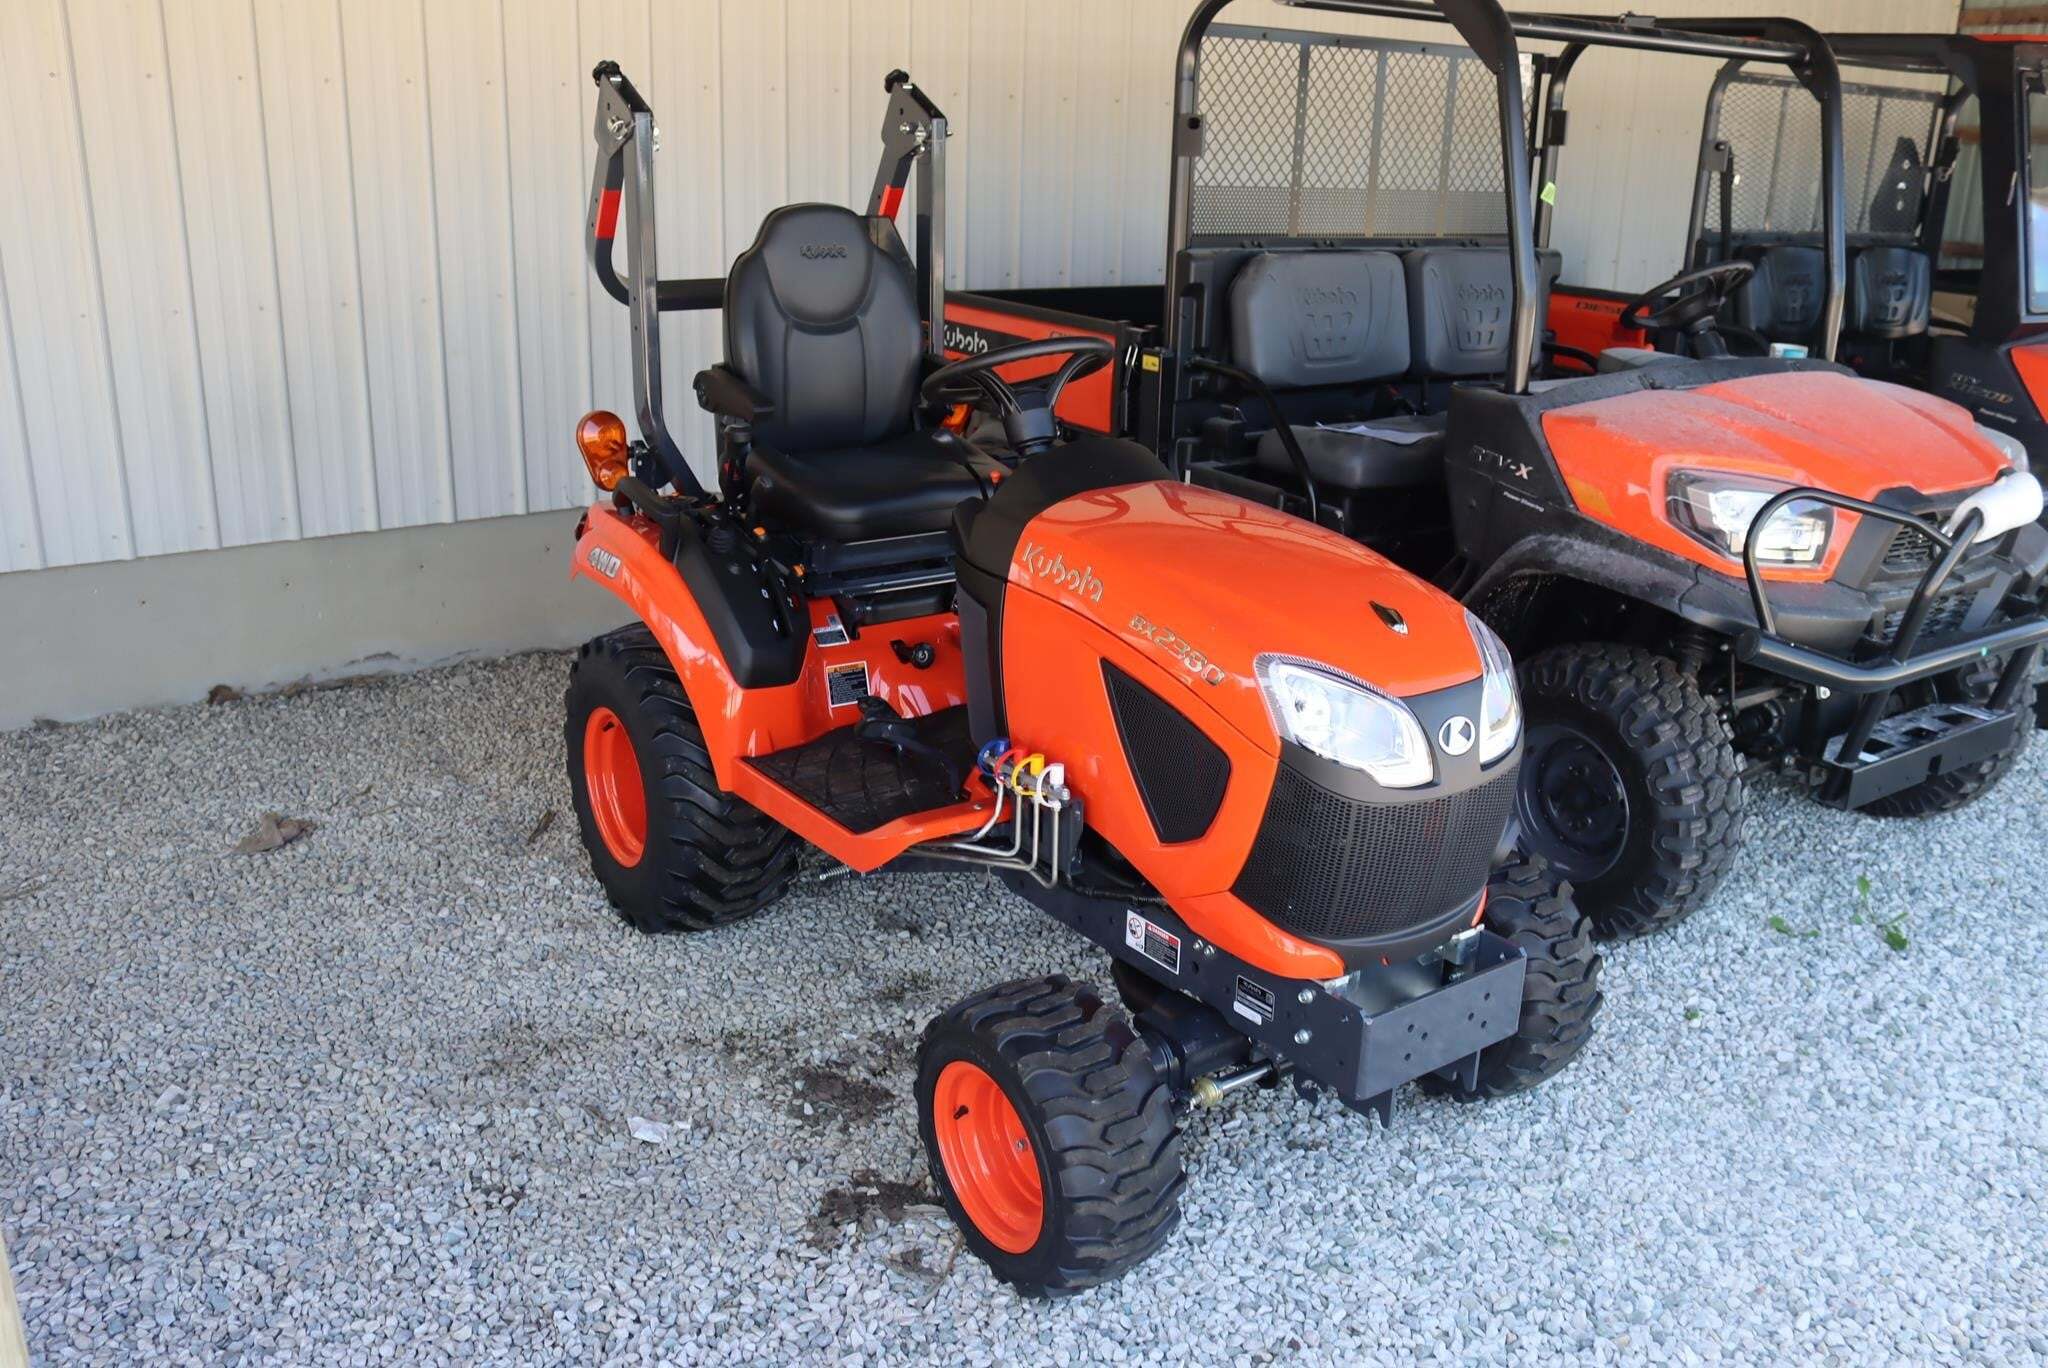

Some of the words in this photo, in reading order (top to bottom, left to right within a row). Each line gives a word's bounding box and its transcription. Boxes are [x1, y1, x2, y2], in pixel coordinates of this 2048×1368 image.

[1575, 301, 1622, 315] DIESE
[589, 545, 622, 579] 4WD
[1021, 541, 1105, 602] Kubota
[1128, 613, 1226, 687] BX2380
